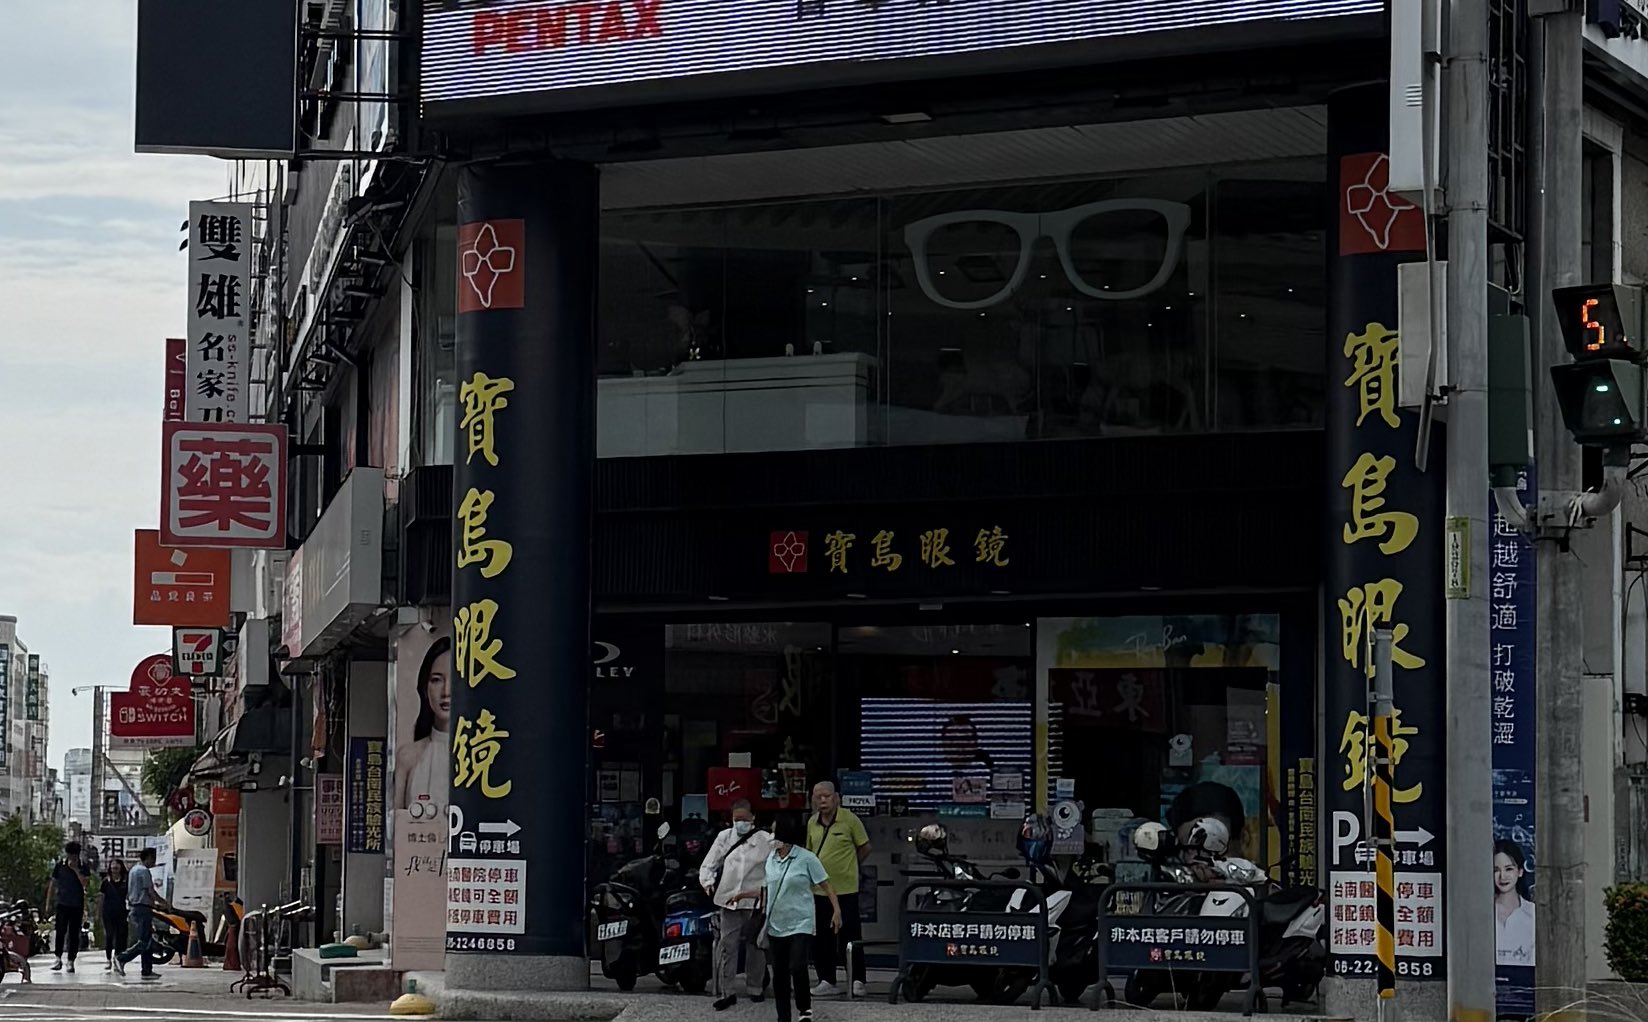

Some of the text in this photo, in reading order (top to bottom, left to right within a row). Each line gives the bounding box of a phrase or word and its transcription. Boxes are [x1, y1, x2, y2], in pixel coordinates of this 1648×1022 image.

[474, 0, 664, 56] PENTAX
[1580, 297, 1606, 352] 5
[226, 335, 239, 423] ss-knife.c
[177, 437, 273, 532] 藥
[453, 371, 517, 799] 寶島眼鏡
[823, 526, 1011, 574] 寶島眼鏡
[1338, 322, 1427, 804] 寶島眼鏡
[1493, 643, 1516, 745] 打破乾澀
[1332, 810, 1361, 866] P
